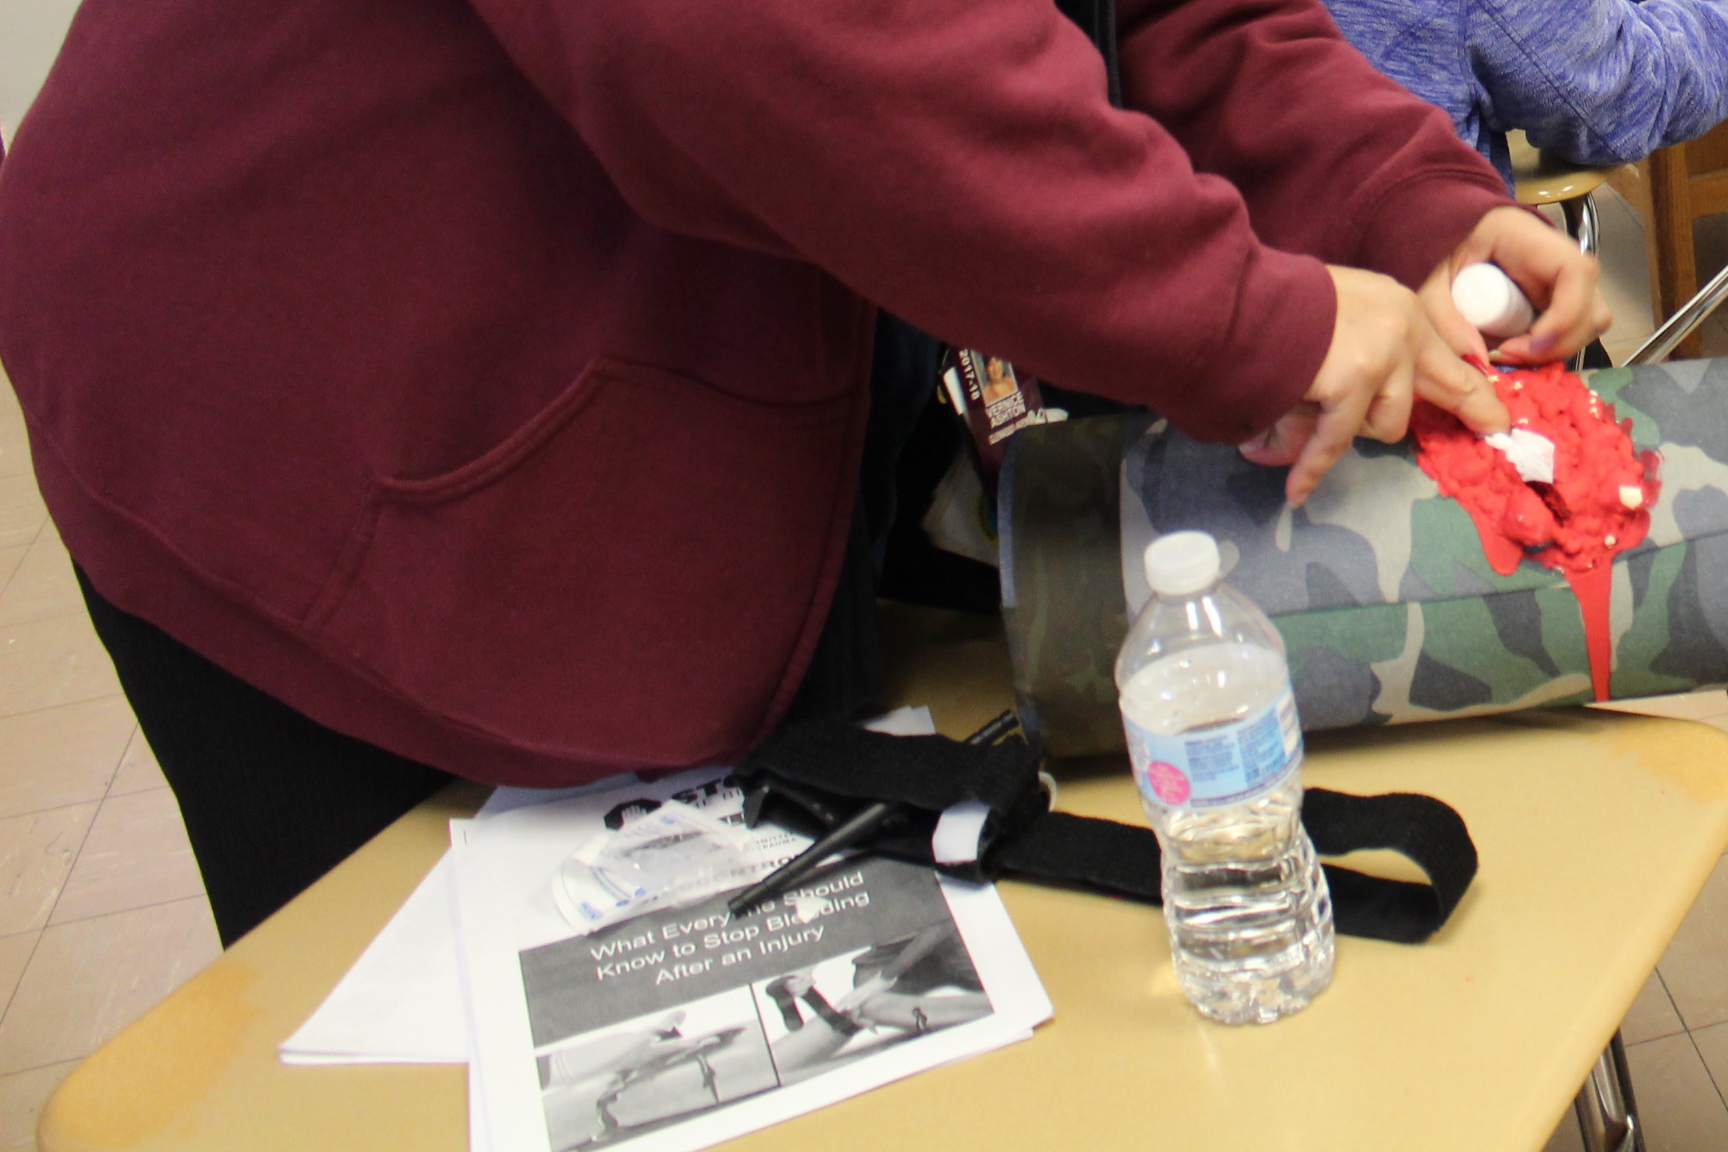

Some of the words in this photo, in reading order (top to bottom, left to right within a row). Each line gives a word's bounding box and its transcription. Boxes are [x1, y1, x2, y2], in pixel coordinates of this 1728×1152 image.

[590, 930, 656, 962] What
[782, 871, 865, 908] Should
[595, 949, 666, 981] Know
[672, 941, 696, 959] to
[702, 924, 761, 951] Stop
[766, 890, 871, 929] Bleding
[655, 958, 714, 985] After
[721, 947, 752, 967] an
[759, 925, 825, 955] Injury
